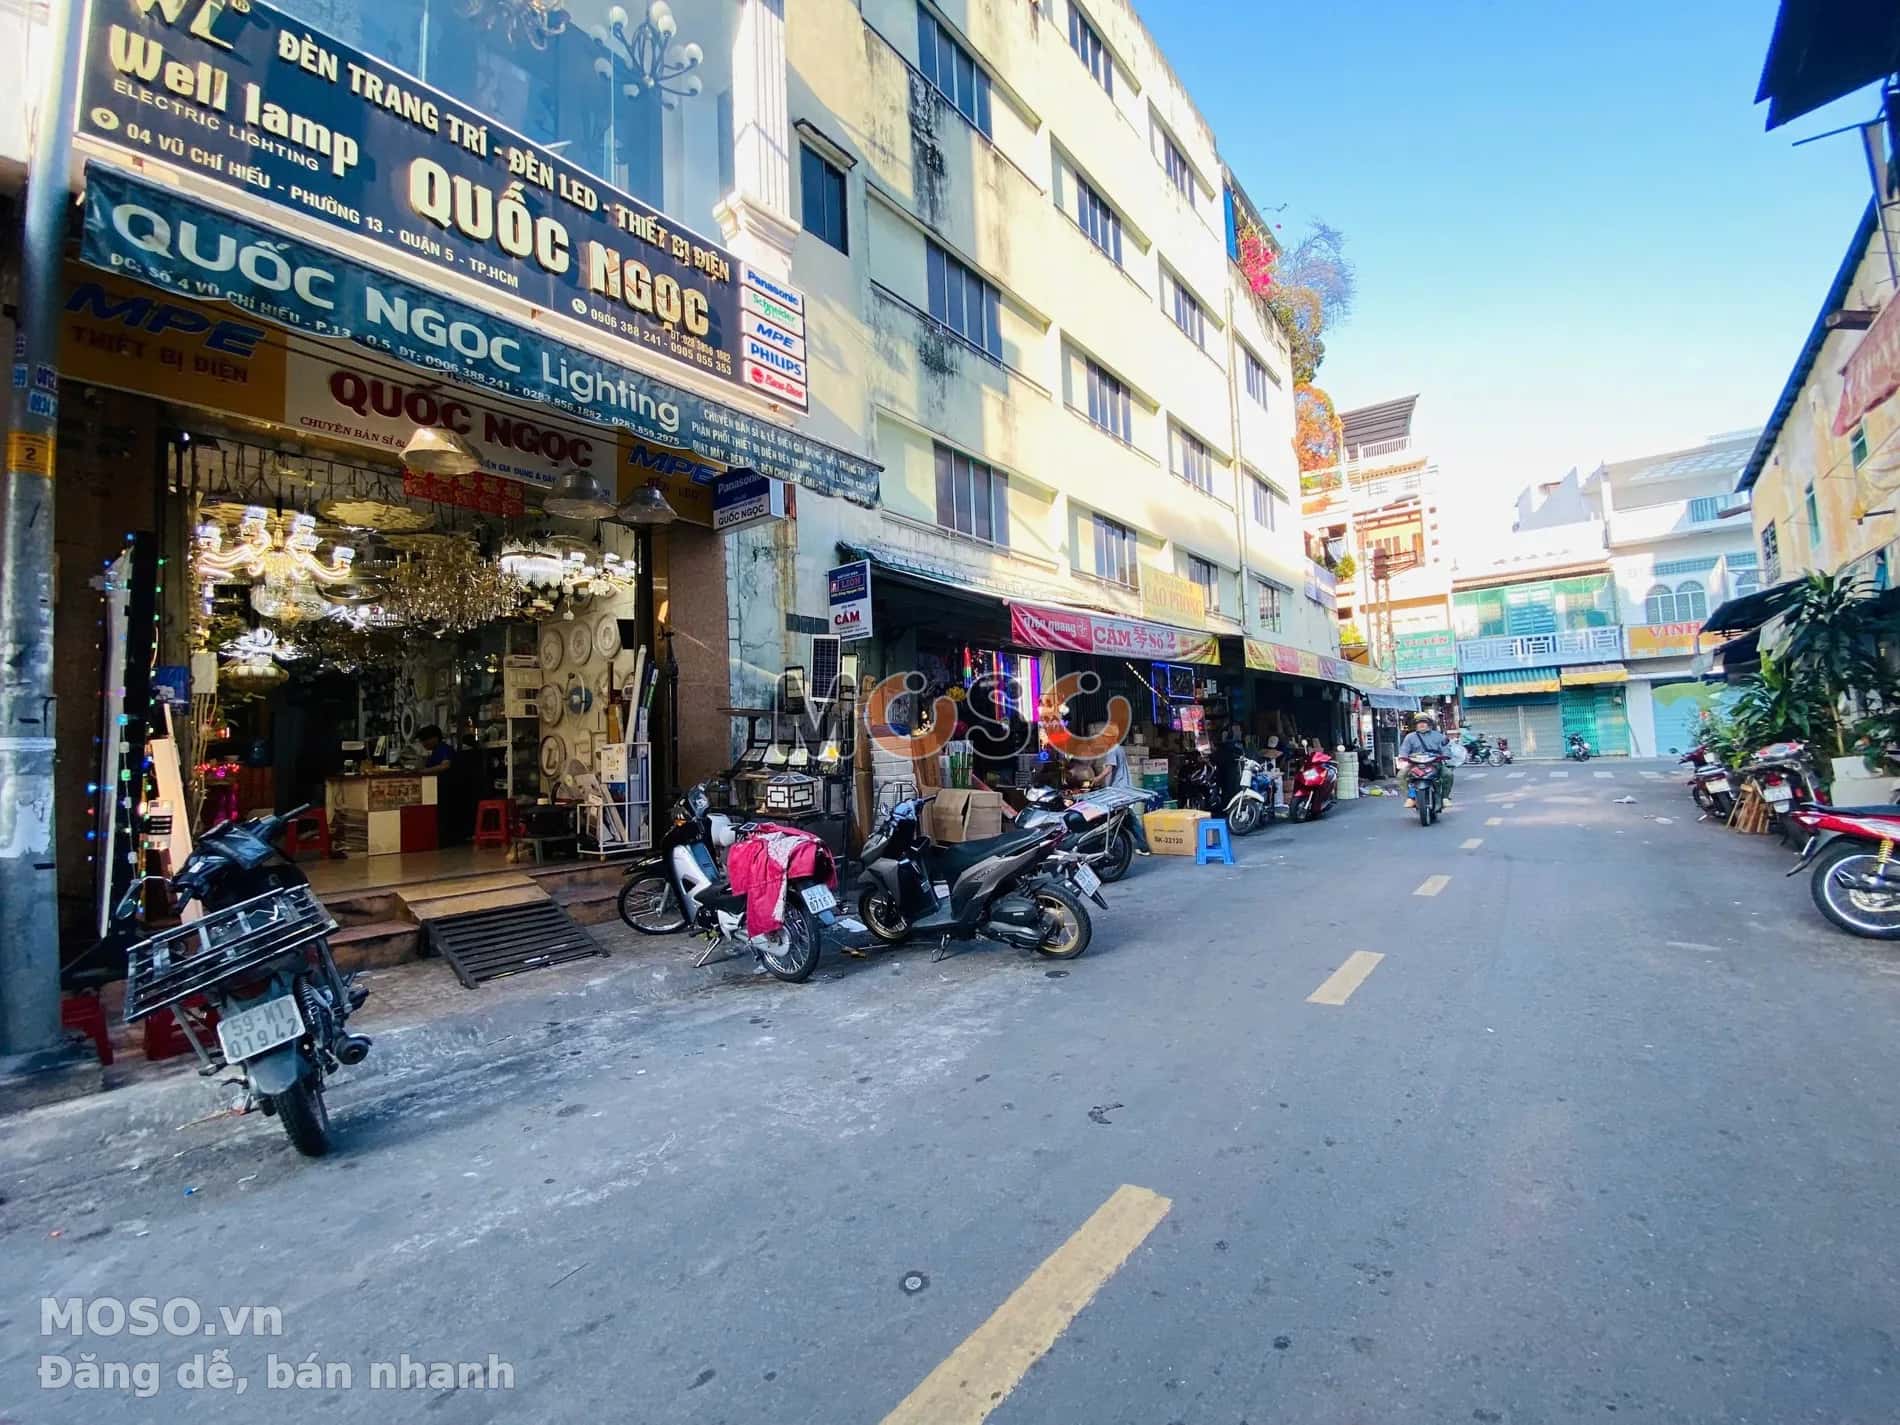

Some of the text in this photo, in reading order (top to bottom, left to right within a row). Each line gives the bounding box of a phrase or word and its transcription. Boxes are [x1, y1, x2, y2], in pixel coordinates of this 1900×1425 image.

[109, 24, 359, 177] Well lamp
[112, 79, 320, 171] ELECTRIC LIGHTING
[278, 29, 730, 286] ĐÈN TRANG TRÍ ĐÈN LED THIẾT BỊ ĐIỆN
[126, 122, 519, 289] 04 VŨ CHÍ HIẾU PHƯỜNG 13 QUẬN 5 TP.HCM
[409, 157, 711, 337] QUỐC NGỌC
[63, 281, 268, 360] MPE
[111, 203, 680, 433] QUỐC NGỌC Lighting
[747, 269, 800, 306] Panasonic
[177, 277, 190, 290] 4
[226, 290, 255, 309] CHÍ
[316, 320, 351, 338] P.13
[425, 355, 511, 391] 0906.388.241
[590, 308, 732, 377] 0906 388 241 0905 055 353
[750, 342, 802, 377] PHILIPS
[756, 323, 795, 350] MPE
[25, 447, 37, 461] 2
[300, 415, 352, 436] CHUYÊN
[354, 428, 380, 443] BÁN
[329, 368, 593, 469] QUỐC NGỌC
[717, 473, 763, 496] Panasonic
[718, 510, 741, 526] QUỐC
[740, 503, 765, 520] NGỌC
